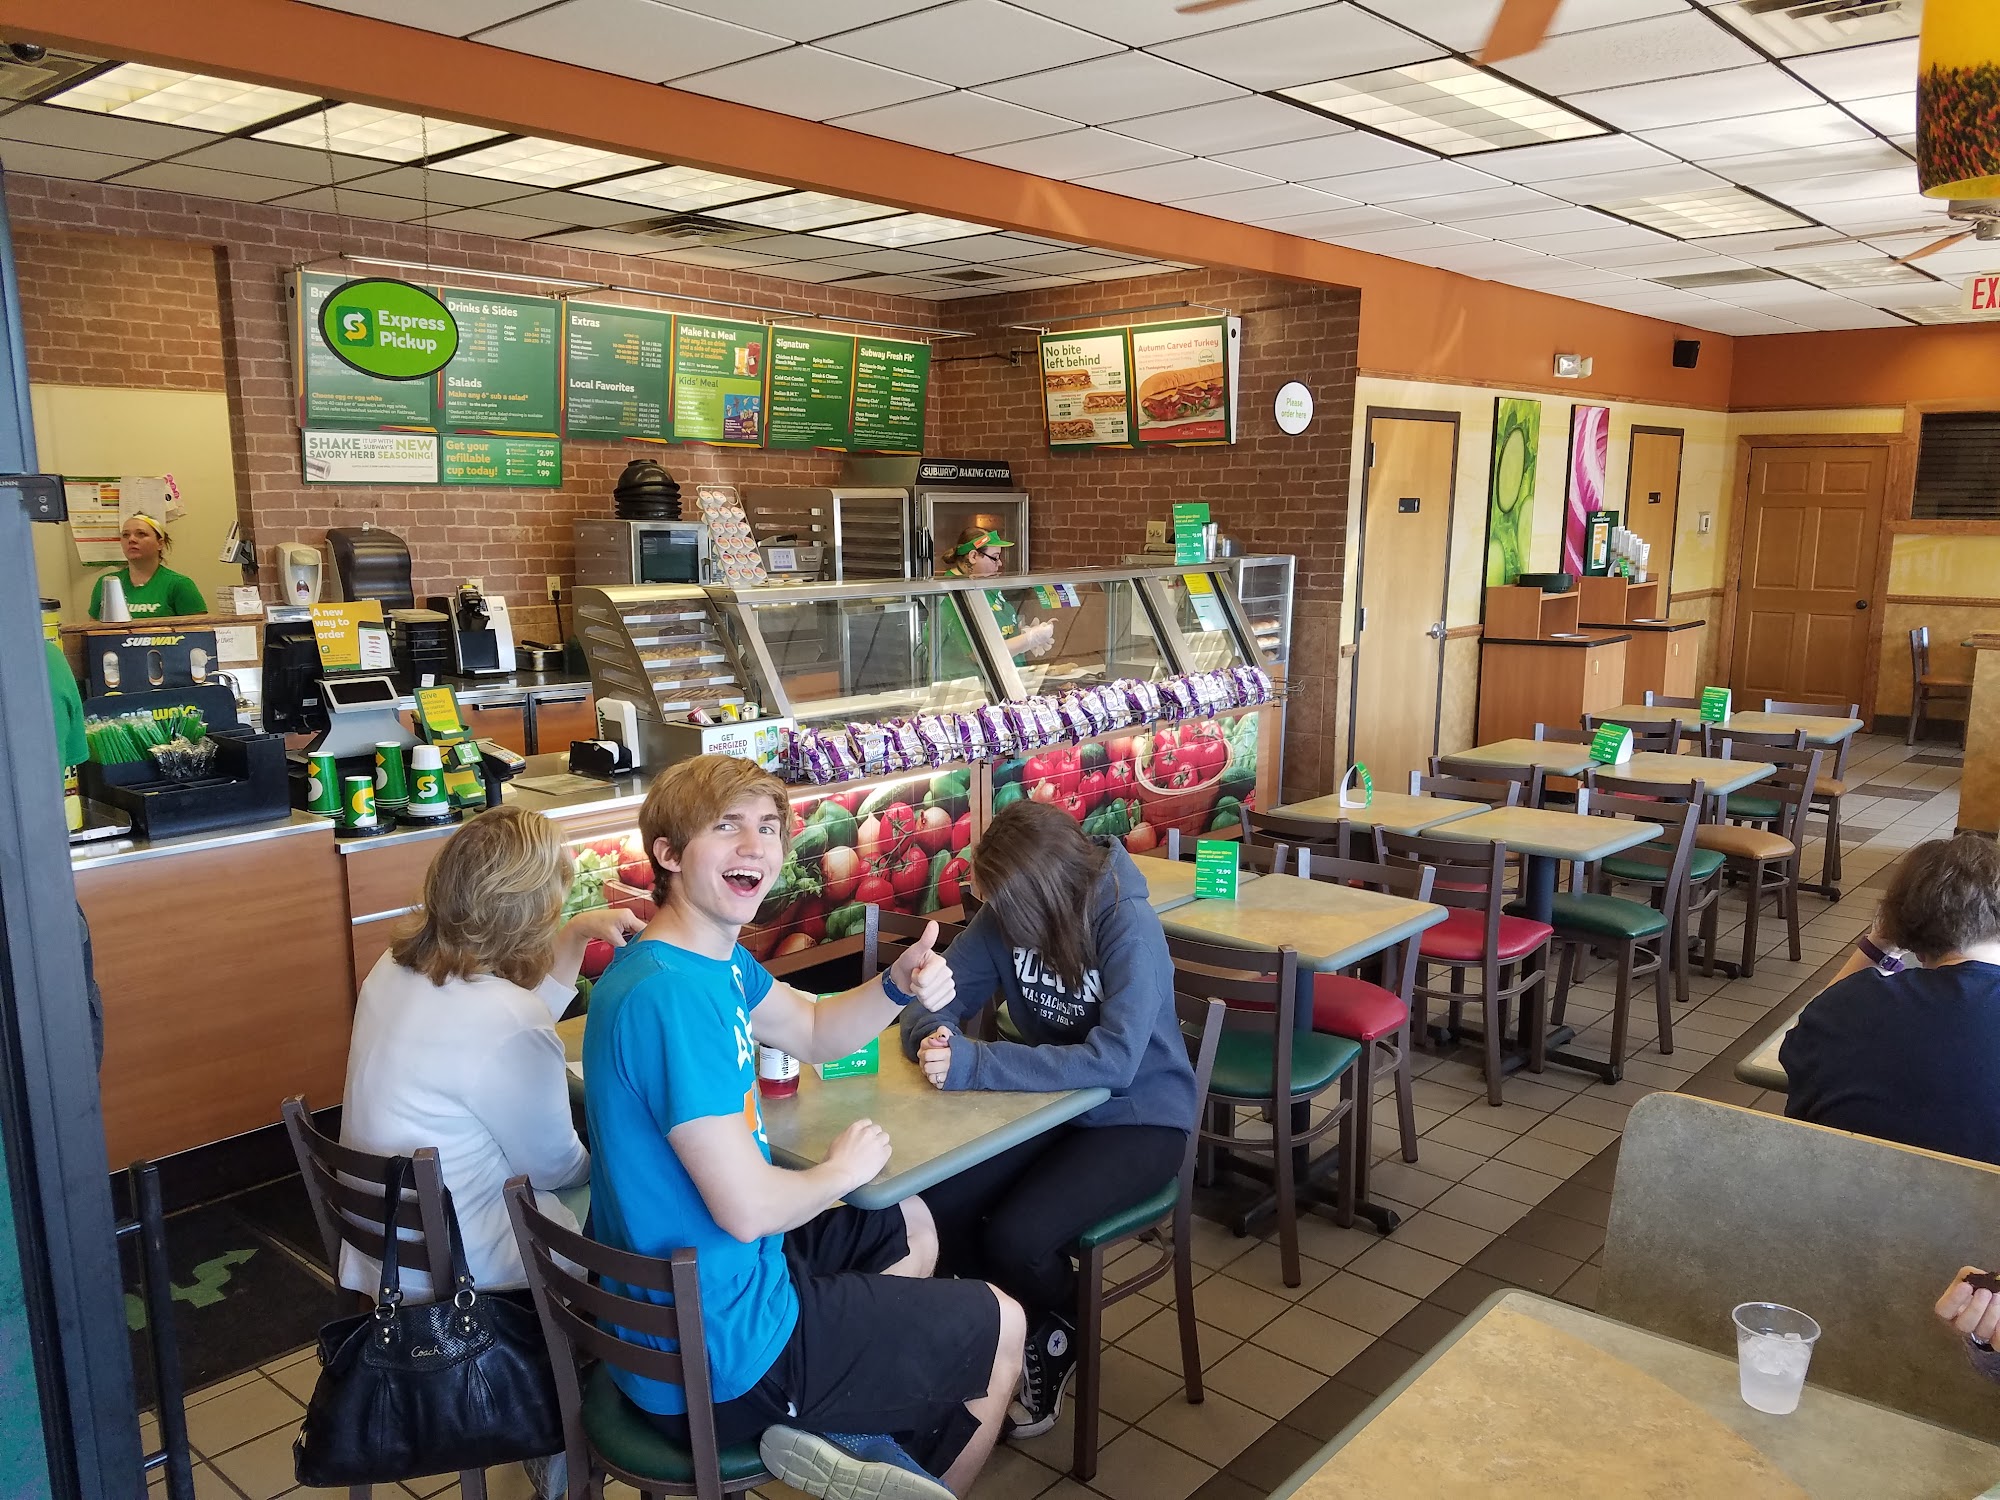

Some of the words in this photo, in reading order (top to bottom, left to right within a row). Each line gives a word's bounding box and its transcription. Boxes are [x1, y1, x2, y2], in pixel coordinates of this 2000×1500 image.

[1972, 277, 2000, 309] EX
[448, 301, 480, 313] Drinks
[482, 305, 489, 314] &
[492, 306, 518, 317] Sides
[378, 310, 446, 332] Express
[571, 315, 600, 327] Extras
[681, 326, 702, 337] Make
[704, 329, 709, 338] it
[718, 331, 736, 341] Meal
[380, 331, 437, 354] Pickup
[776, 338, 810, 349] Signature
[1167, 340, 1192, 350] Carved
[1194, 339, 1219, 347] Turkey
[861, 348, 885, 360] Subway
[886, 351, 903, 360] Fresh
[1046, 347, 1060, 357] No
[1062, 345, 1081, 355] bite
[1047, 358, 1064, 369] left
[1067, 354, 1100, 367] behind
[448, 377, 482, 388] Salads
[570, 378, 593, 389] Local
[595, 381, 635, 392] Favorites
[679, 377, 698, 385] Kids'
[700, 379, 718, 387] Meal
[468, 392, 480, 400] any
[1287, 398, 1303, 407] Please
[1281, 409, 1295, 418] order
[1296, 410, 1306, 419] here
[309, 437, 360, 450] SHAKE
[396, 439, 433, 450] NEW
[446, 440, 464, 450] Get
[467, 442, 489, 452] your
[310, 450, 348, 459] SAVORY
[350, 451, 375, 459] HERB
[378, 451, 433, 460] SEASONING!
[446, 453, 490, 463] refillable
[446, 467, 464, 477] cup
[466, 466, 497, 477] today!
[922, 467, 956, 477] SUBWAY
[959, 468, 984, 477] BAKING
[985, 469, 1009, 478] CENTER
[313, 608, 321, 616] A
[318, 630, 345, 639] order
[121, 635, 185, 647] SUBWAY
[420, 692, 437, 700] Give
[709, 740, 747, 752] ENERGIZED
[410, 1344, 442, 1358] Coach
